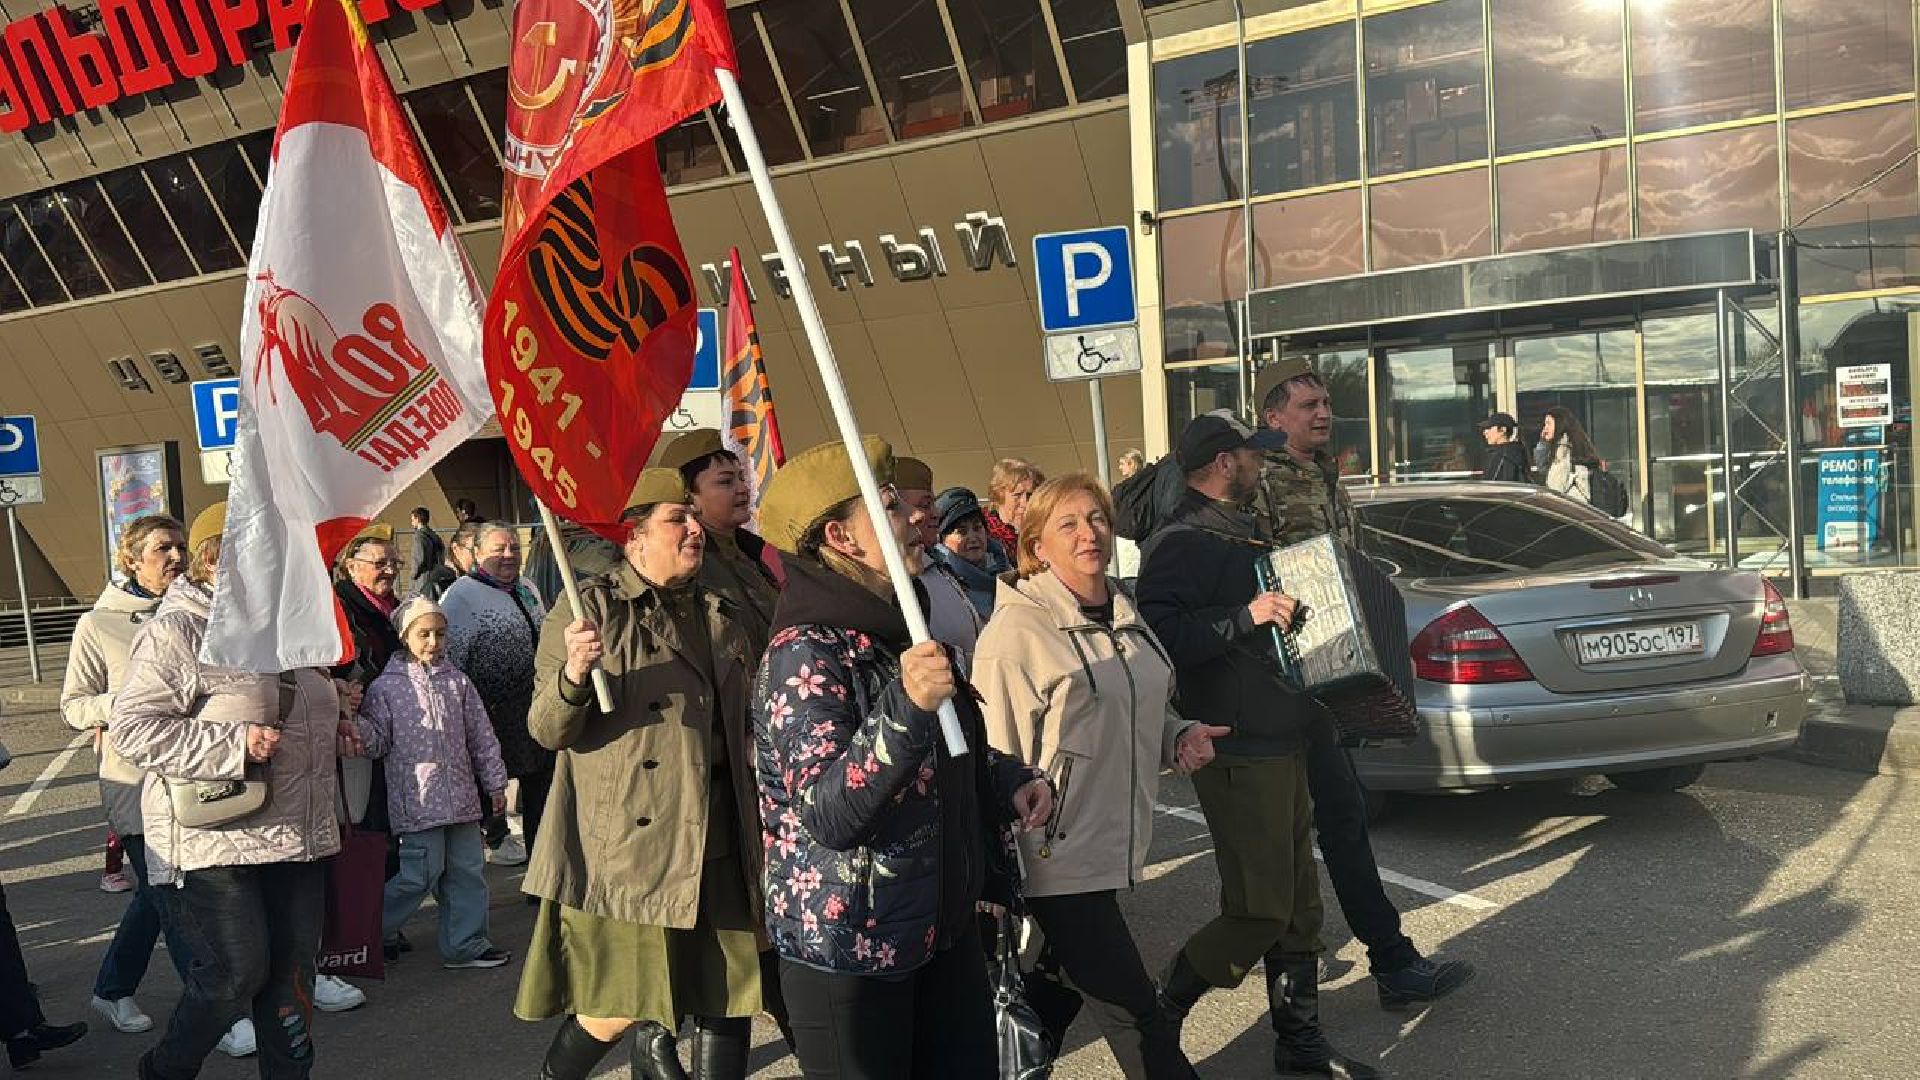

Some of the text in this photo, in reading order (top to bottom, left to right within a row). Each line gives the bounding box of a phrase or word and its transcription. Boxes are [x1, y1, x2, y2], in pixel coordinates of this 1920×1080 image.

[1062, 242, 1112, 317] P
[500, 379, 577, 509] 1945
[1821, 458, 1875, 472] РЕМОНТ
[1667, 624, 1693, 643] 197
